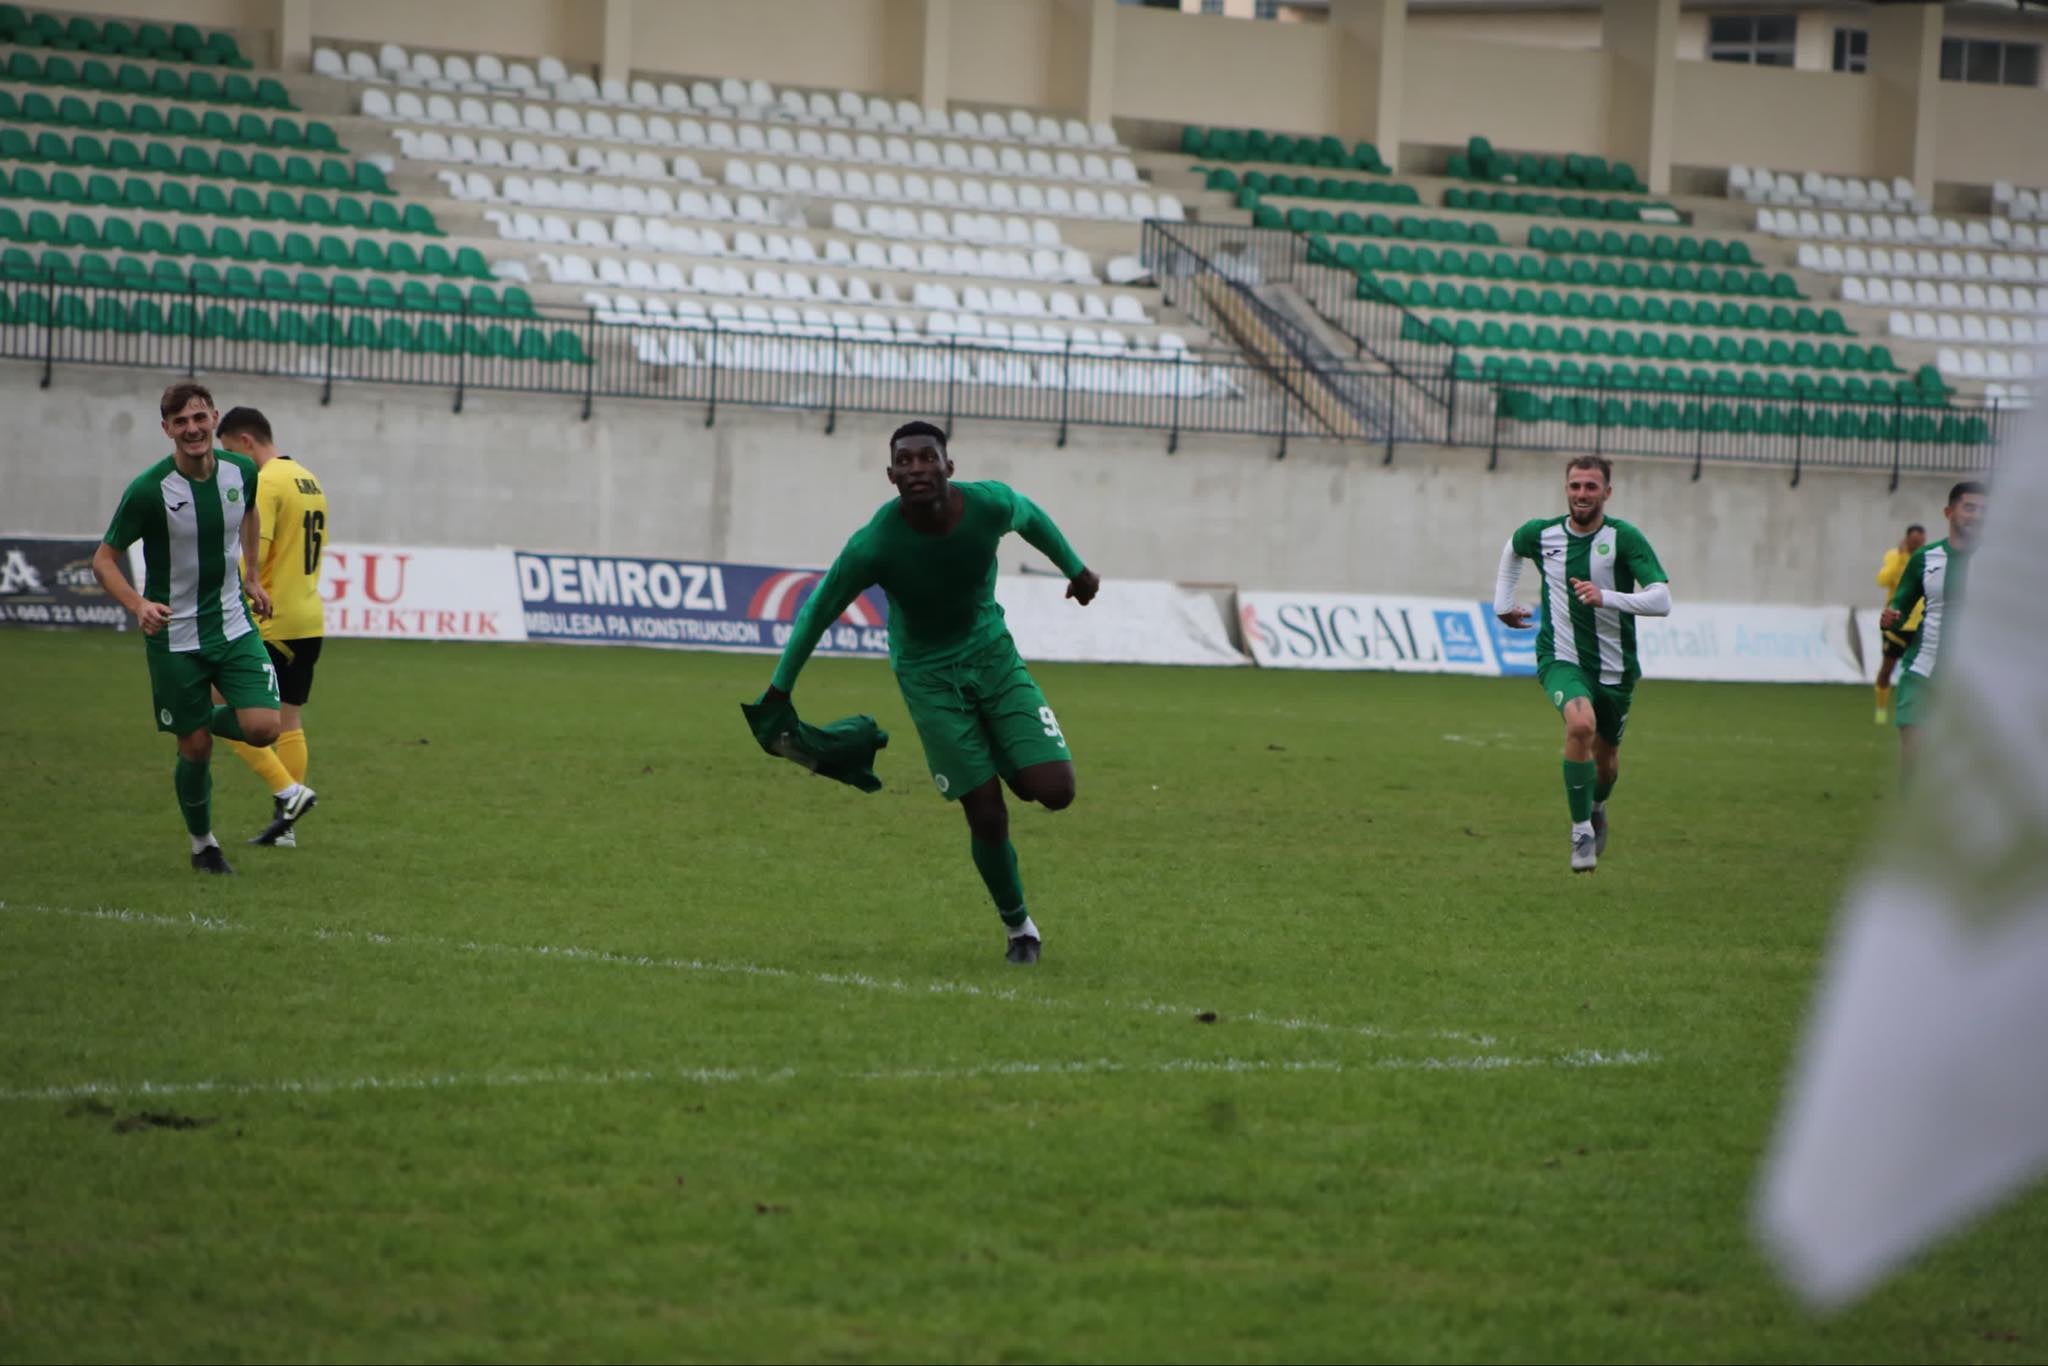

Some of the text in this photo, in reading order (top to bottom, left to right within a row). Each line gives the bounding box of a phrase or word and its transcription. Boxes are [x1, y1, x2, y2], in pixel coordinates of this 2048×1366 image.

[303, 510, 324, 575] 16
[517, 555, 727, 611] DEMROZI
[606, 618, 629, 637] PA
[631, 619, 760, 644] KONSTRUKSION
[1277, 603, 1439, 662] SIGAL
